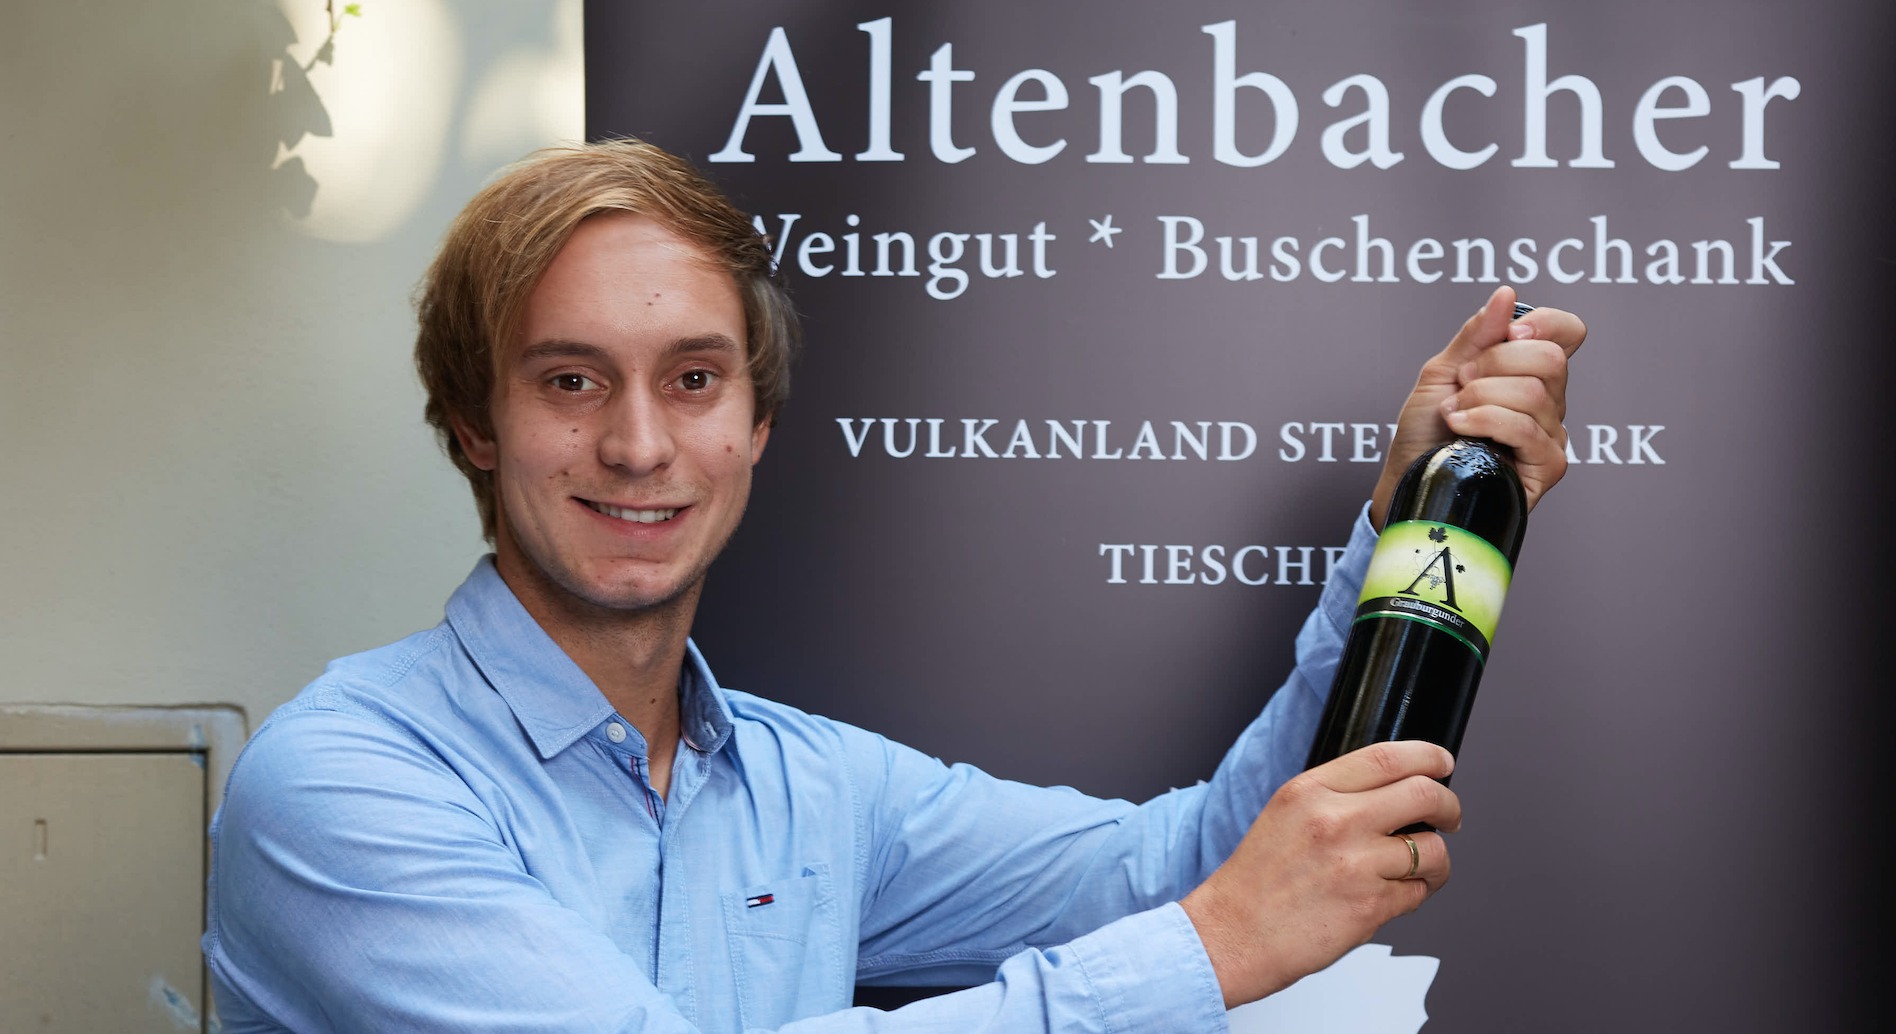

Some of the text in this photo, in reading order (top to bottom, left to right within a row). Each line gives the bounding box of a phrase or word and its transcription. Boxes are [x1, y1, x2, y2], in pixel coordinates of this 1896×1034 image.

[709, 17, 1801, 171] Altenbacher
[1155, 212, 1795, 287] Buschenschank
[836, 417, 1258, 462] VULKANLAND
[1099, 543, 1348, 586] TIESCHE
[1397, 546, 1463, 613] A
[1389, 597, 1466, 628] Grauburgunder
